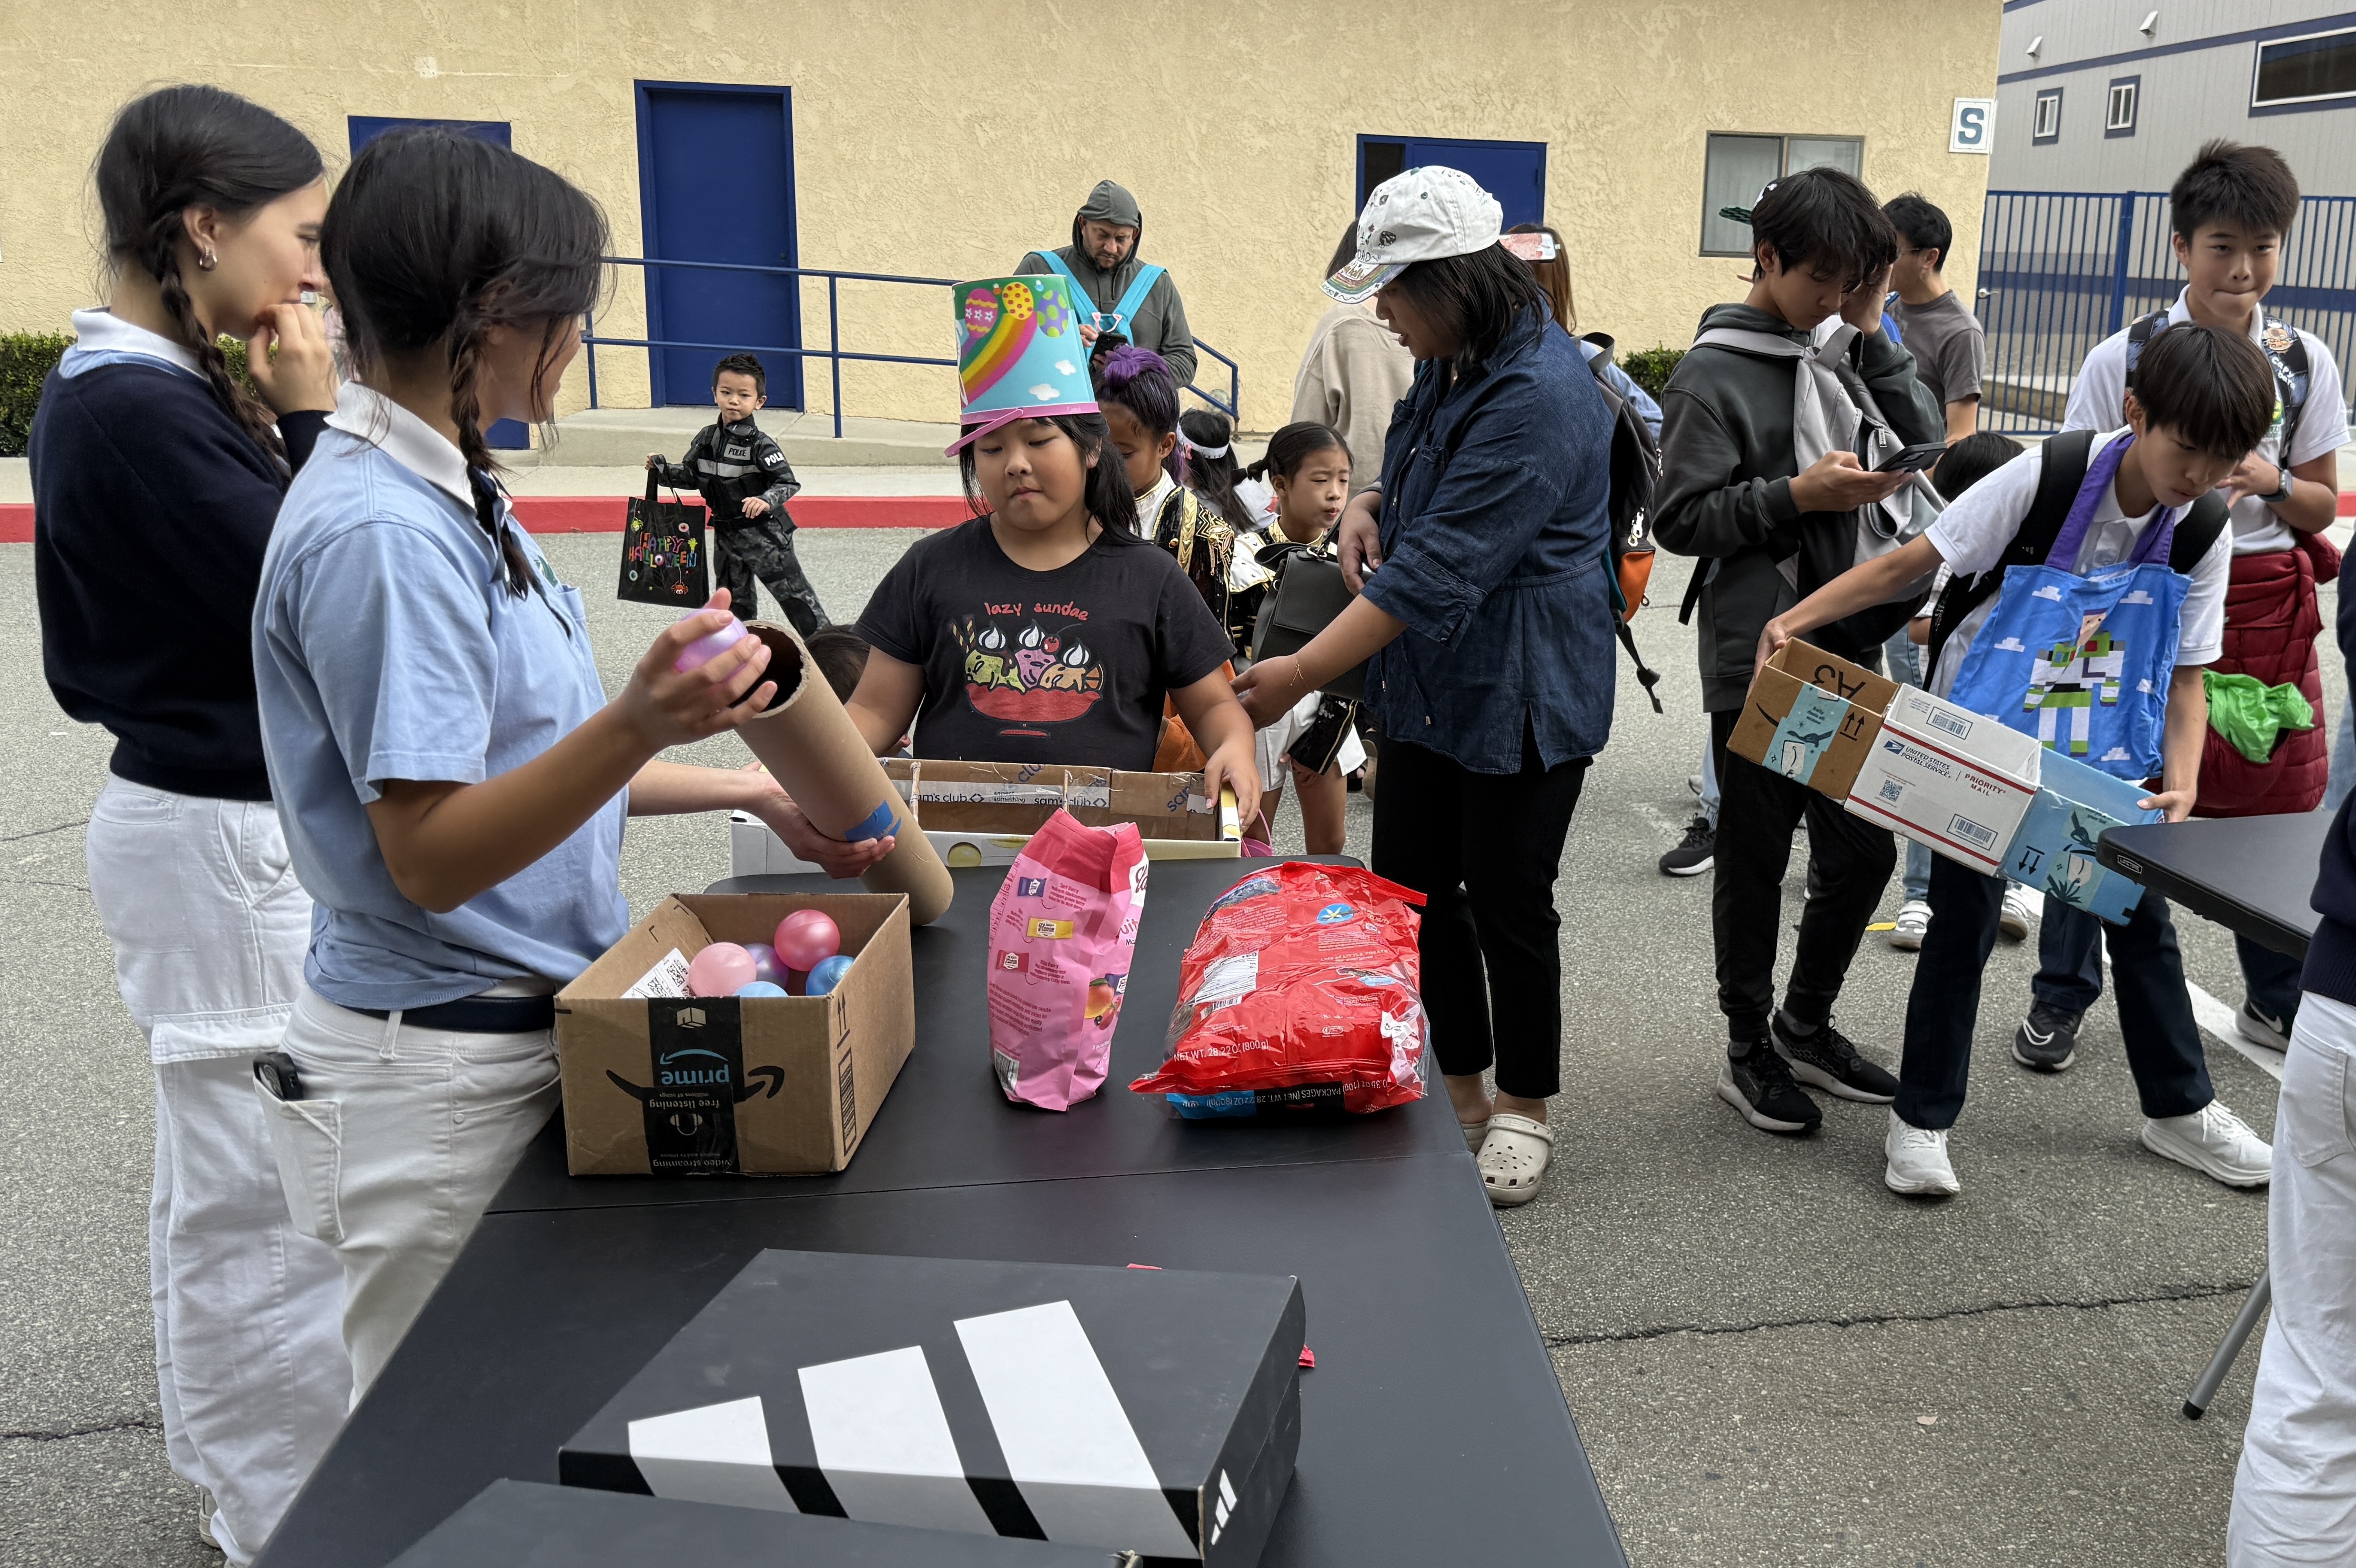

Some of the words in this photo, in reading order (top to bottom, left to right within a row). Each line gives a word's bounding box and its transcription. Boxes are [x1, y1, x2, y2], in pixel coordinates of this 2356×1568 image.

[1957, 107, 1985, 145] S
[764, 452, 784, 466] POLI
[639, 532, 684, 554] HAPPY
[629, 545, 697, 568] HALLOWEEN
[984, 602, 1022, 616] lazy
[1033, 601, 1089, 621] sundae
[1900, 752, 1923, 766] POSTAL
[1923, 763, 1949, 777] SERVICE
[1905, 746, 1929, 760] UNITED
[1929, 756, 1951, 771] STATES
[1018, 764, 1042, 783] clu
[1965, 773, 2003, 794] PRIORITY
[1970, 783, 1990, 796] MAIL
[943, 793, 968, 802] club
[1173, 1051, 1189, 1063] NET
[1190, 1049, 1207, 1060] WT.
[1208, 1046, 1231, 1057] 28.22
[661, 1064, 730, 1085] prime
[1301, 1087, 1341, 1099] PACKAGES
[649, 1099, 696, 1109] listening
[699, 1099, 720, 1108] free
[652, 1159, 701, 1169] streaming
